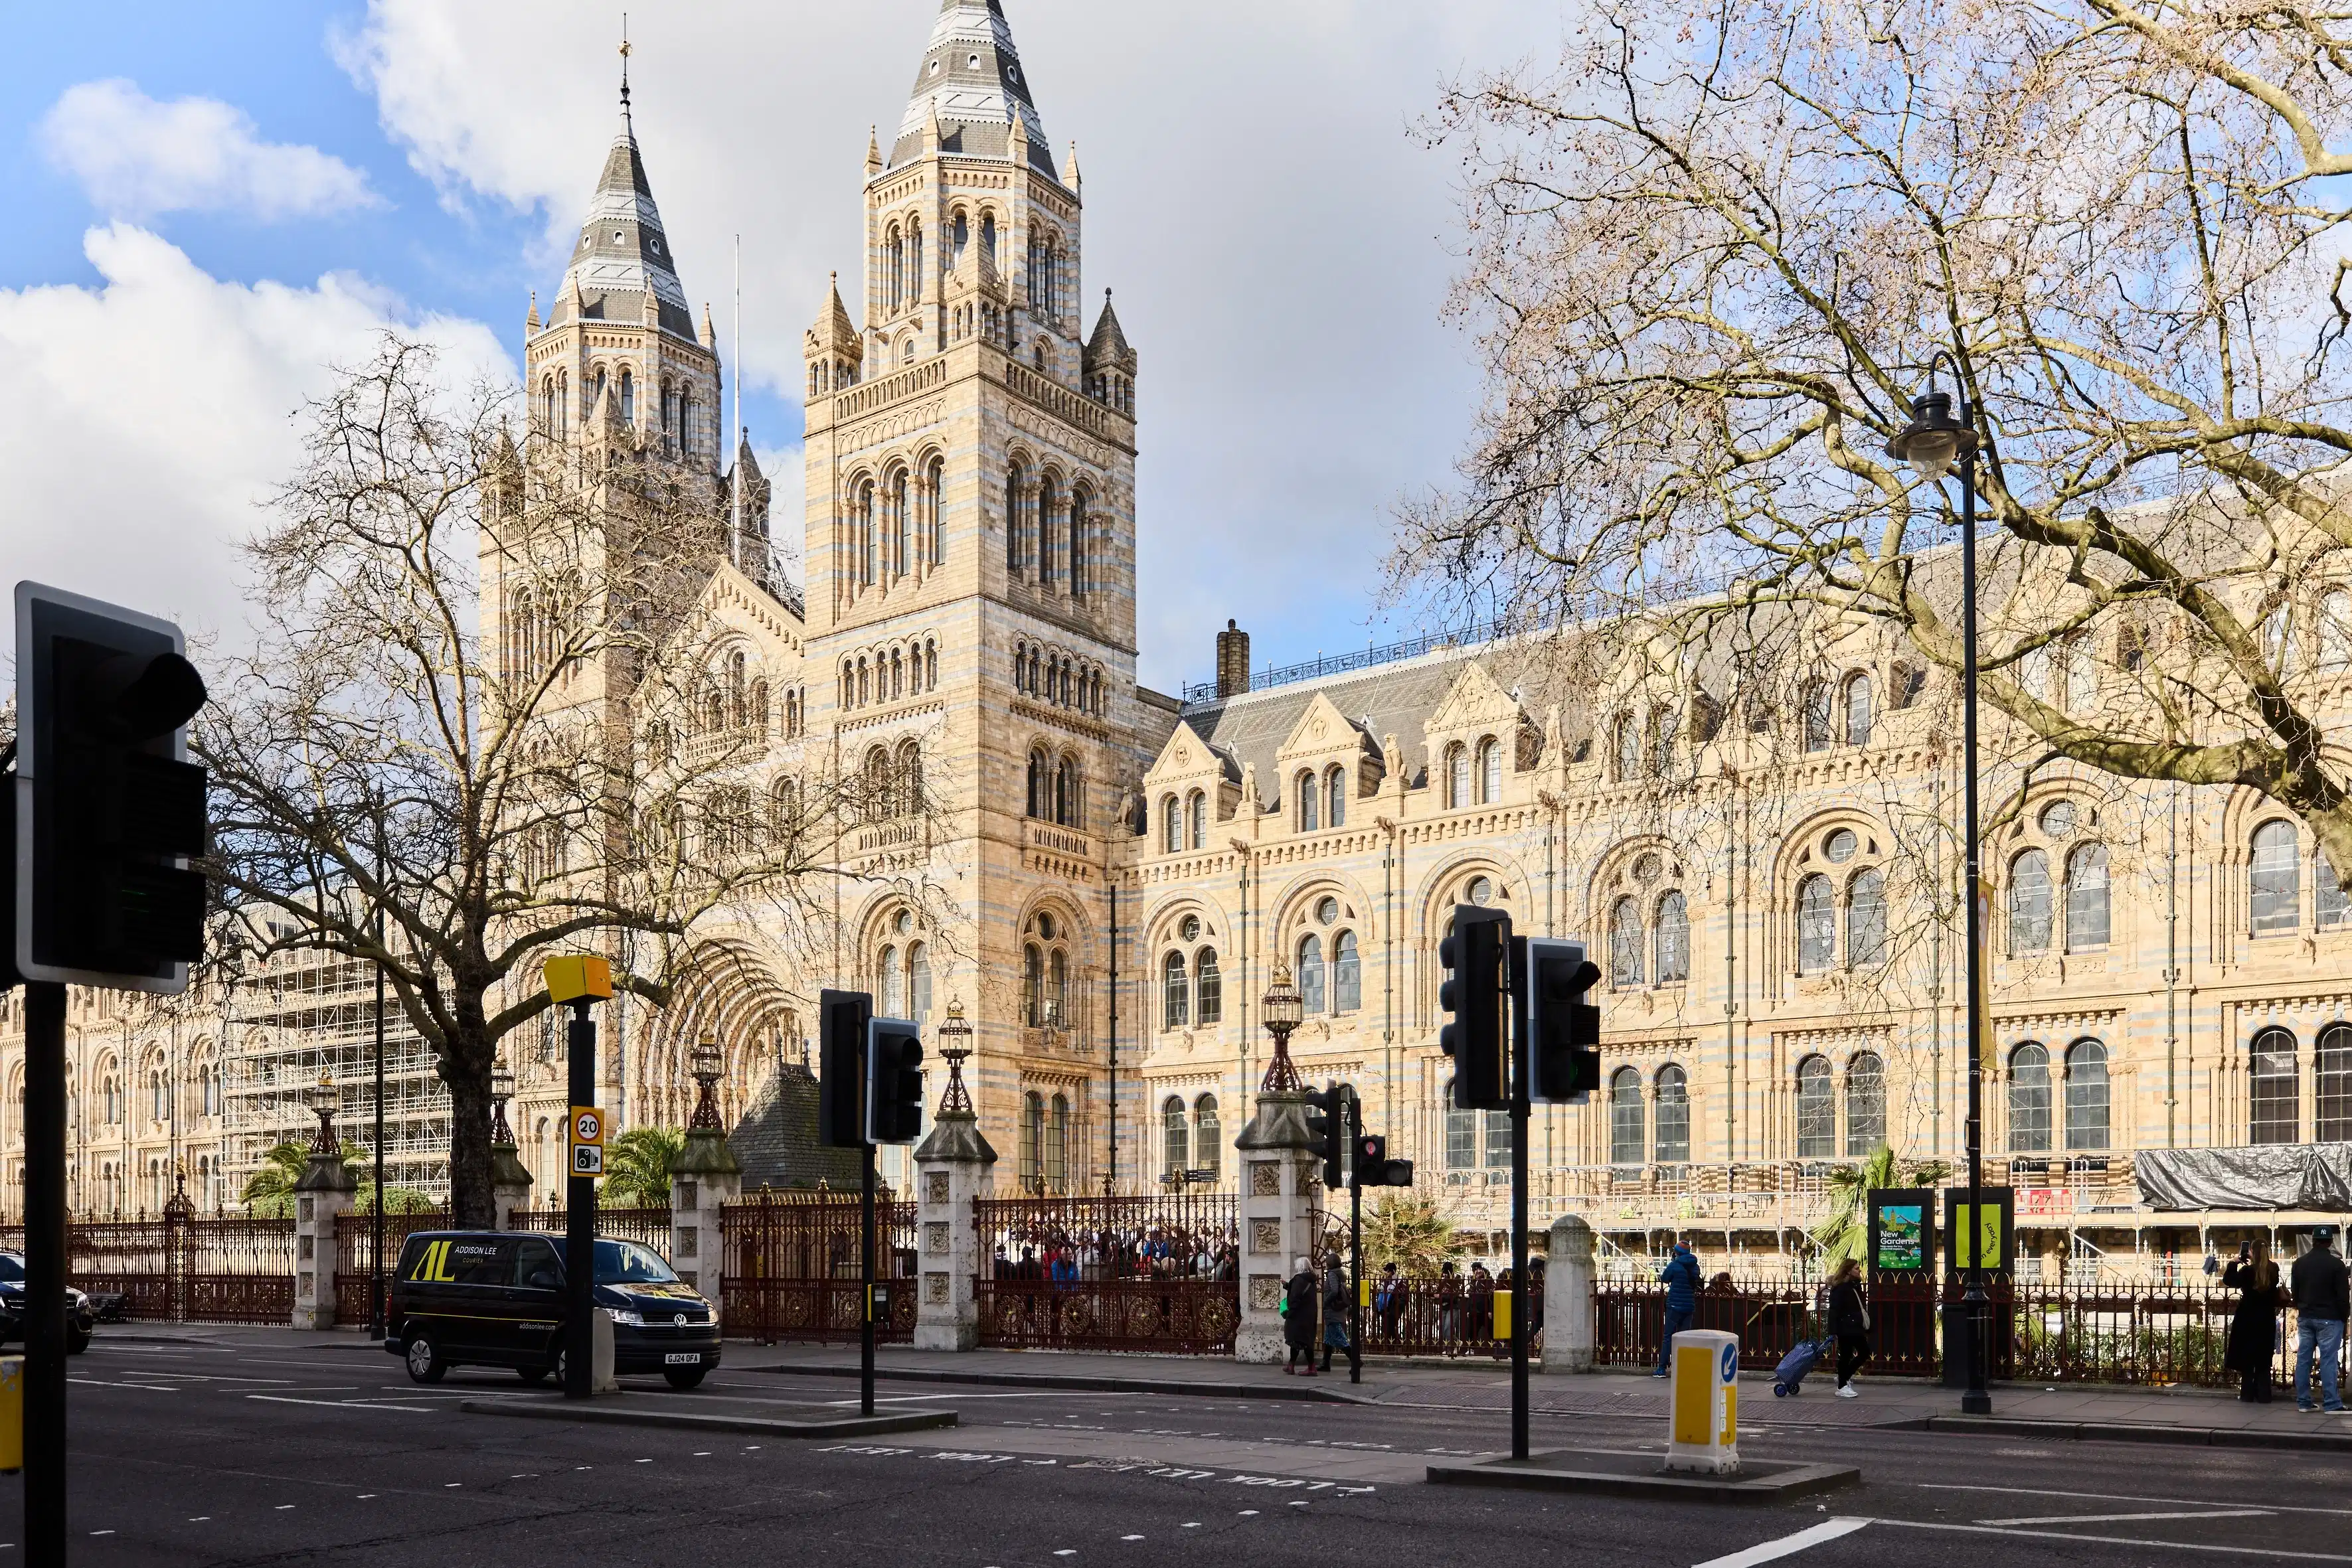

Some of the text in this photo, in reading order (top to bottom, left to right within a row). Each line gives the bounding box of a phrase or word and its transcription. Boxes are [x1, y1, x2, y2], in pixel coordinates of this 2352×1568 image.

[580, 1120, 597, 1133] 20
[1984, 1222, 1997, 1255] everyday
[454, 1246, 483, 1255] ADDISON
[410, 1241, 456, 1282] AL
[519, 1322, 556, 1330] addisonlee.com
[1215, 1475, 1336, 1490] LOOK
